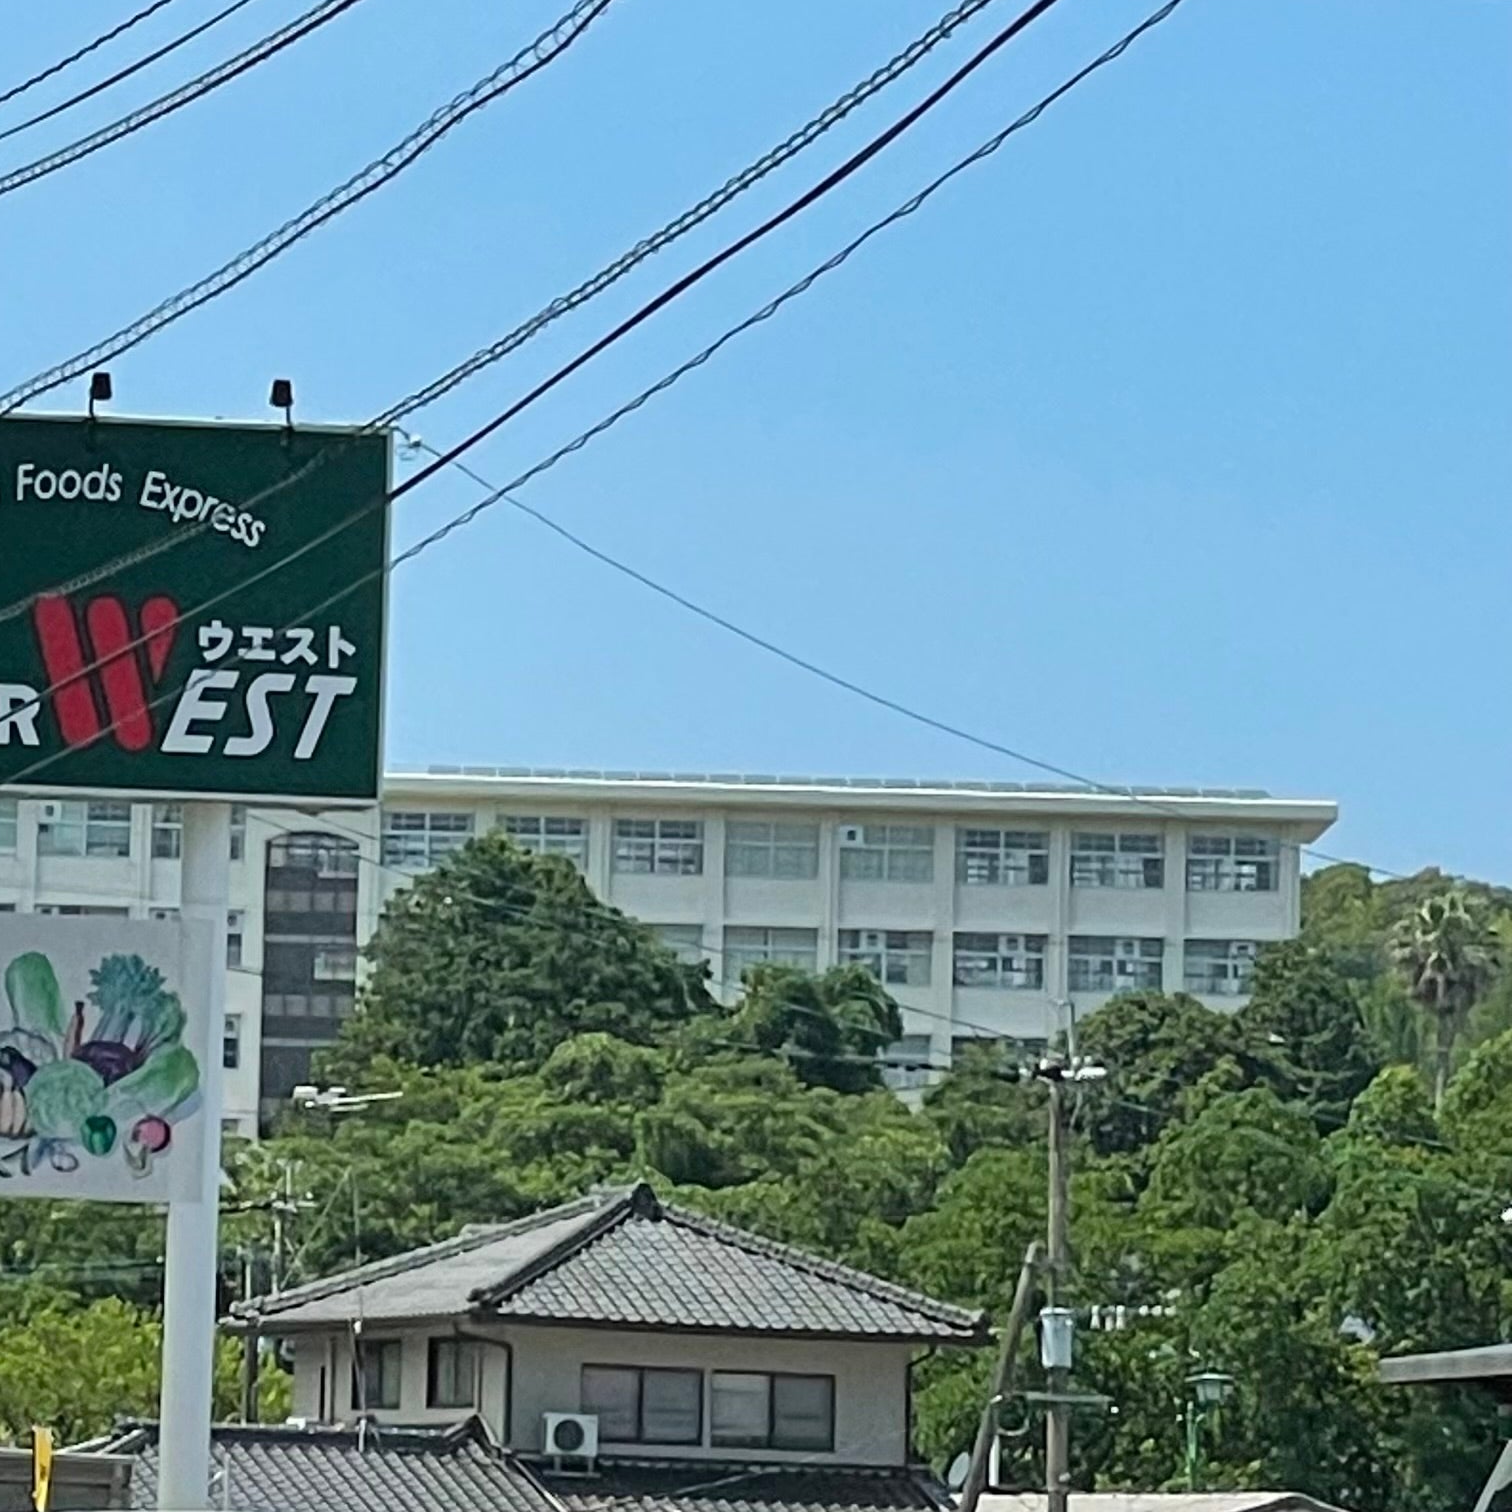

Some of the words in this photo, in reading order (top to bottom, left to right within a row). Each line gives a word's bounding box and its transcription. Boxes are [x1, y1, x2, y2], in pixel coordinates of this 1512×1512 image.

[17, 464, 122, 502] Foods
[140, 472, 265, 547] Express
[199, 621, 356, 669] ウエスト
